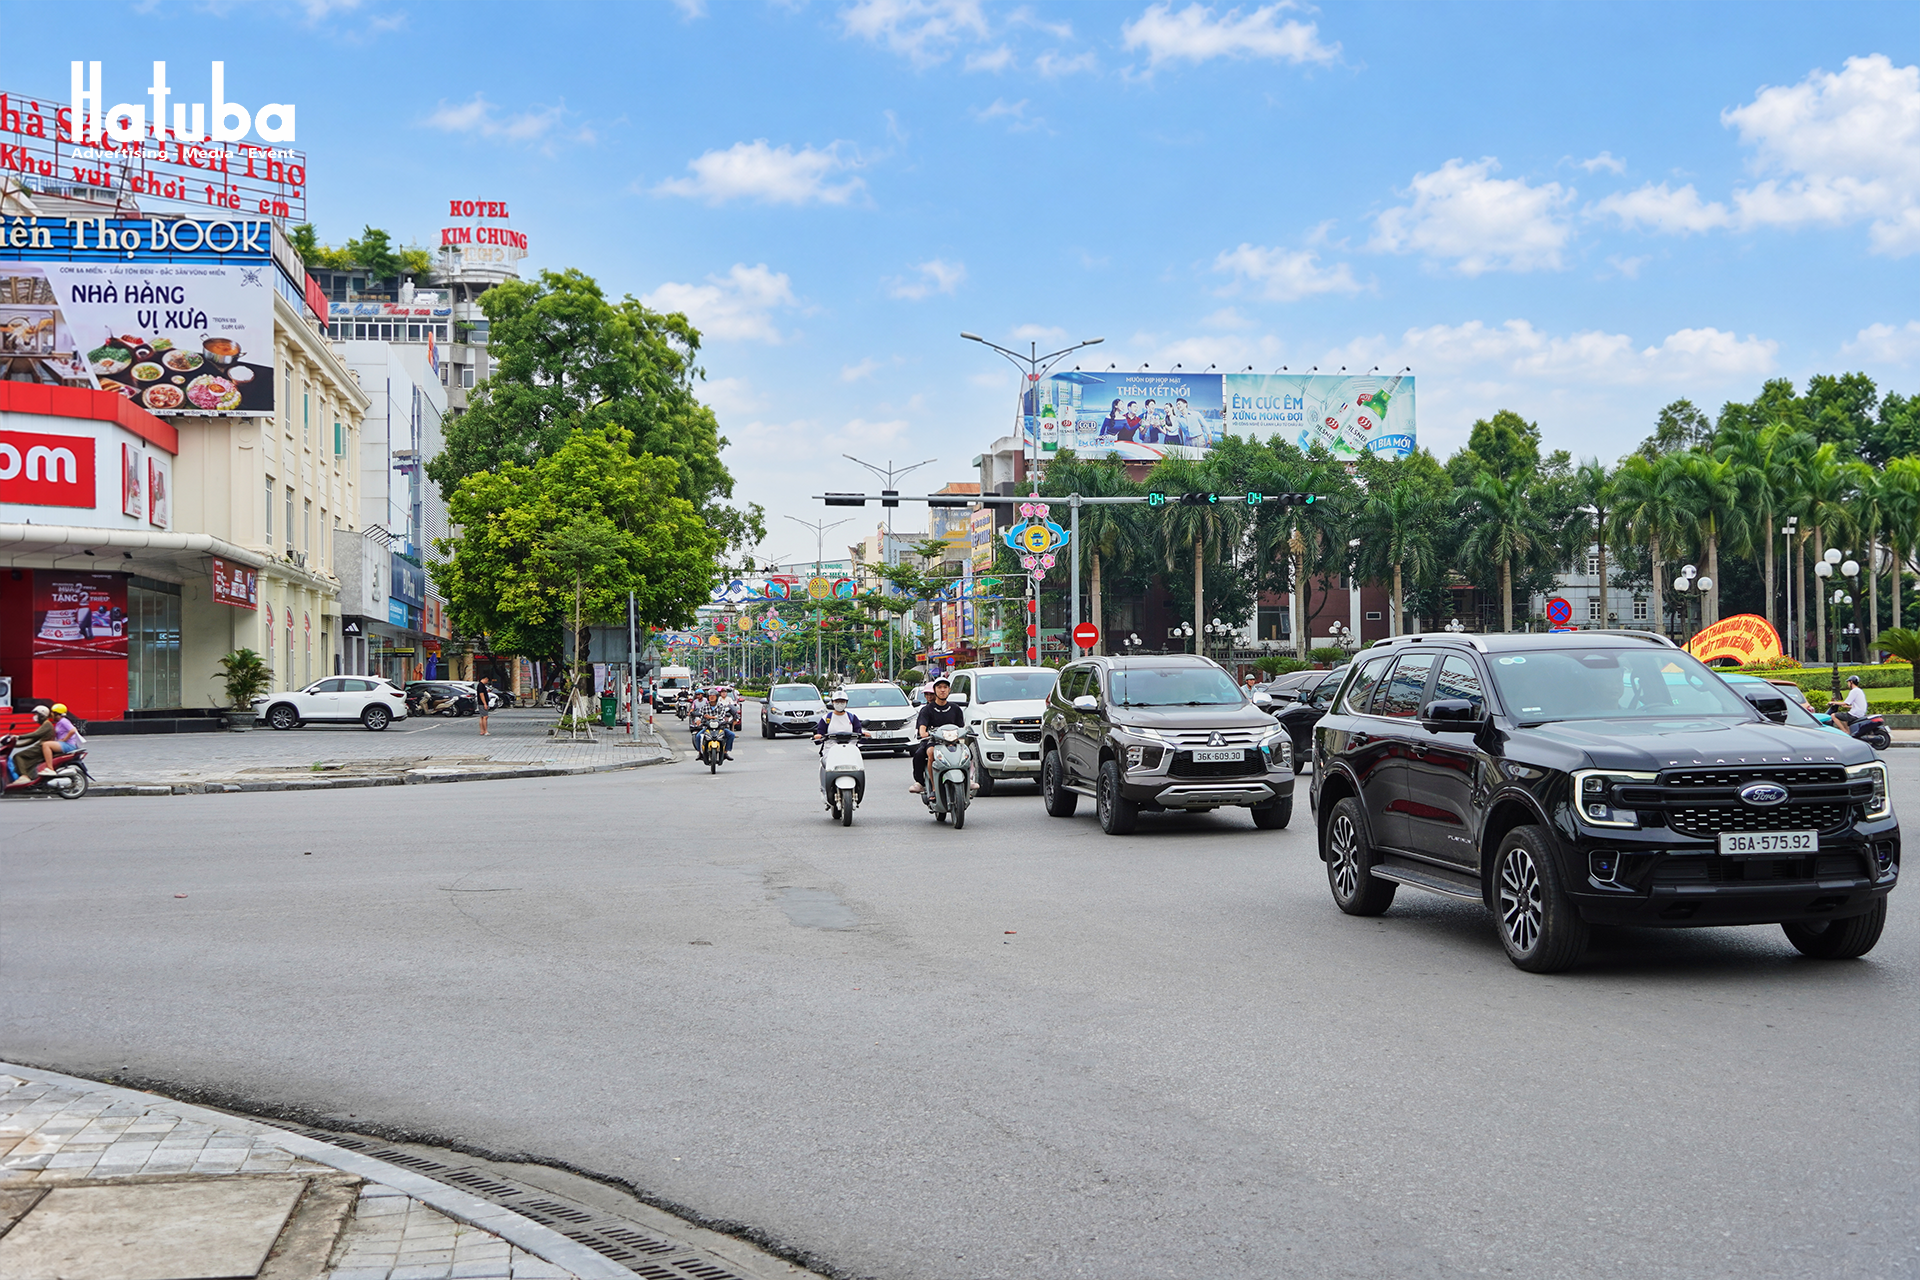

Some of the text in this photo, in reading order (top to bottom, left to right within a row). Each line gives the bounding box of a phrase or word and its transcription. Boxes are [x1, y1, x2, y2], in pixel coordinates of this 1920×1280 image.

[238, 143, 307, 198] Thọ
[0, 142, 289, 218] Khu vui chơi trẻ em
[65, 217, 141, 260] Thọ
[151, 218, 265, 253] BOOK
[441, 226, 528, 250] KIM CHUNG
[72, 280, 185, 304] NHÀ HÀNG
[137, 307, 208, 335] VỊ XƯA
[1116, 384, 1191, 397] THÊM KẾT NỐI
[1232, 393, 1303, 411] ÊM CỰC ÊM
[1232, 410, 1303, 422] XỨNG MONG ĐỢI
[1378, 437, 1392, 448] BIA
[1393, 436, 1411, 449] MỚI
[1149, 492, 1165, 506] 04
[1247, 491, 1262, 505] 04
[1197, 752, 1241, 761] 36K-609.30
[1752, 789, 1777, 801] Ford
[1728, 835, 1811, 851] 36A-575.92
